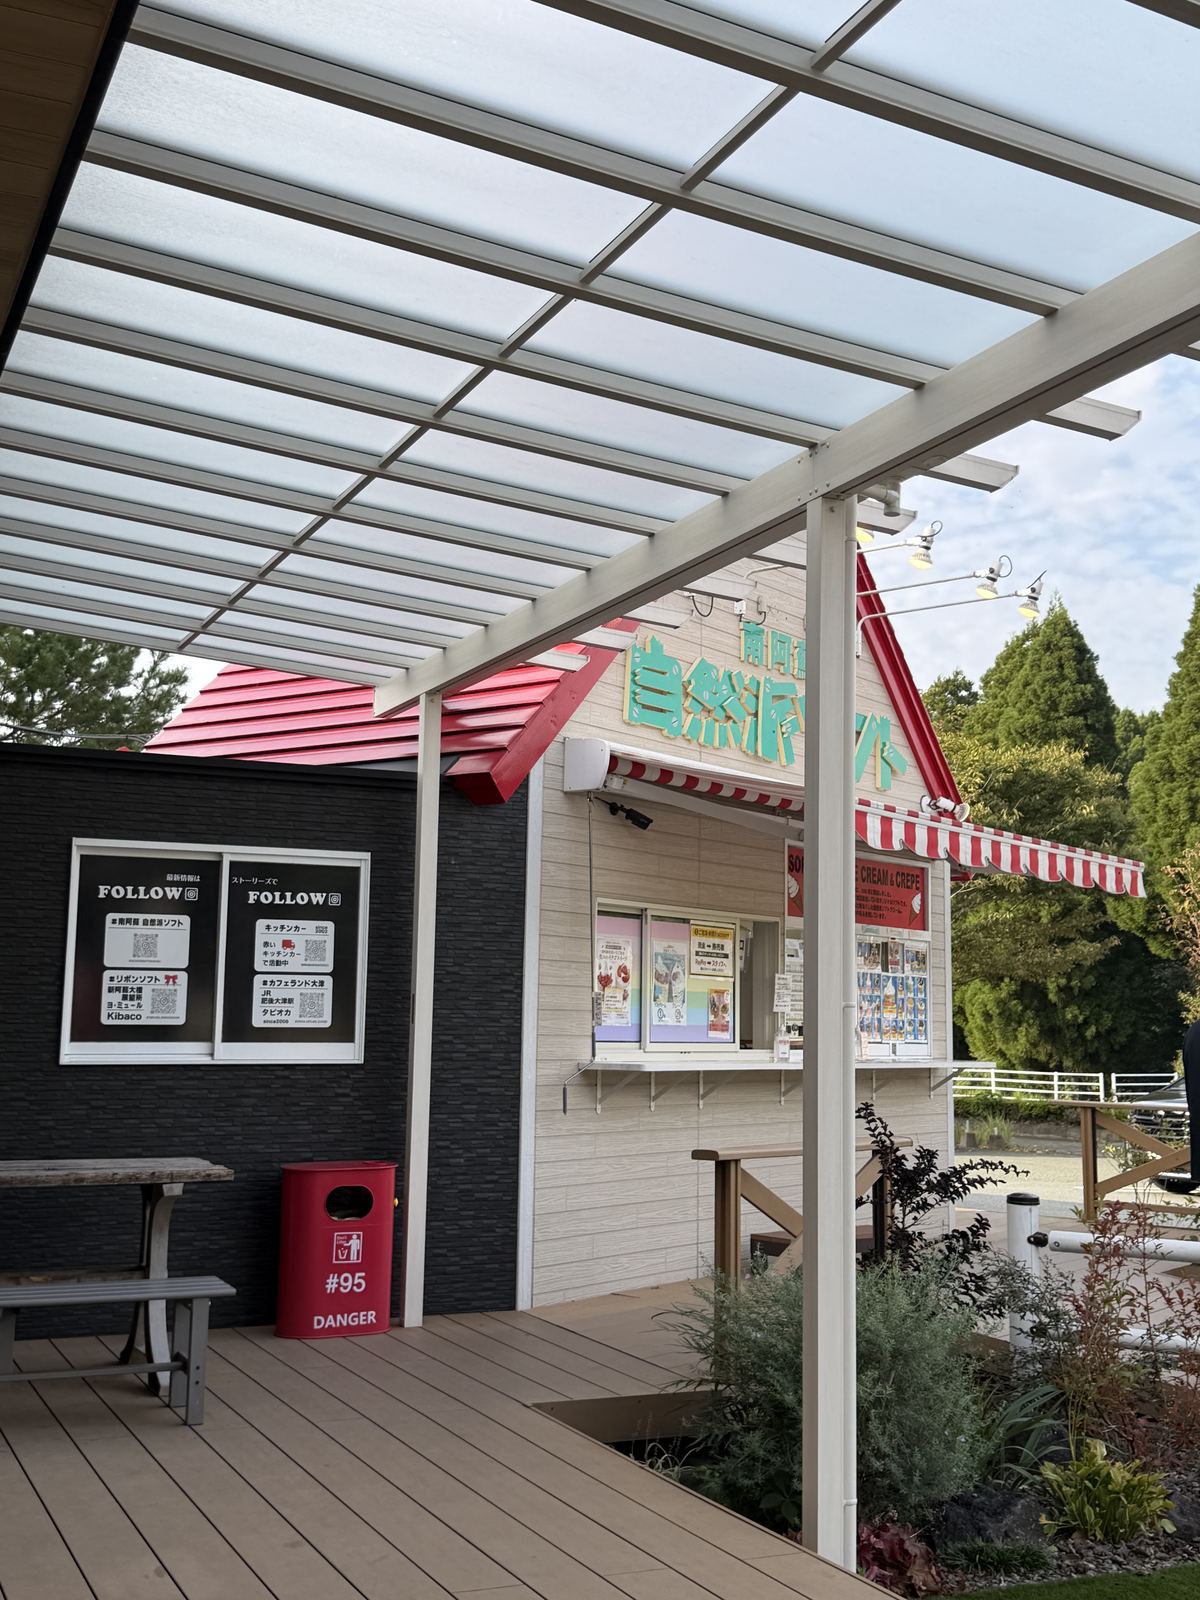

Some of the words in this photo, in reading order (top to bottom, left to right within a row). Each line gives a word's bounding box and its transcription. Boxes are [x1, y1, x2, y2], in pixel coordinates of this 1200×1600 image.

[231, 876, 279, 886] ストーリーズで
[861, 866, 889, 886] CREAM
[890, 873, 895, 886] &
[896, 872, 921, 891] CREPE
[97, 885, 183, 900] FOLLOW
[247, 891, 327, 905] FOLLOW
[265, 924, 307, 933] キッチンカー
[262, 941, 277, 949] 赤い
[262, 950, 302, 958] キッチンカー
[262, 959, 289, 967] で活動中
[107, 1012, 142, 1020] Kibaco
[325, 1272, 366, 1294] #95
[313, 1311, 377, 1329] DANGER
